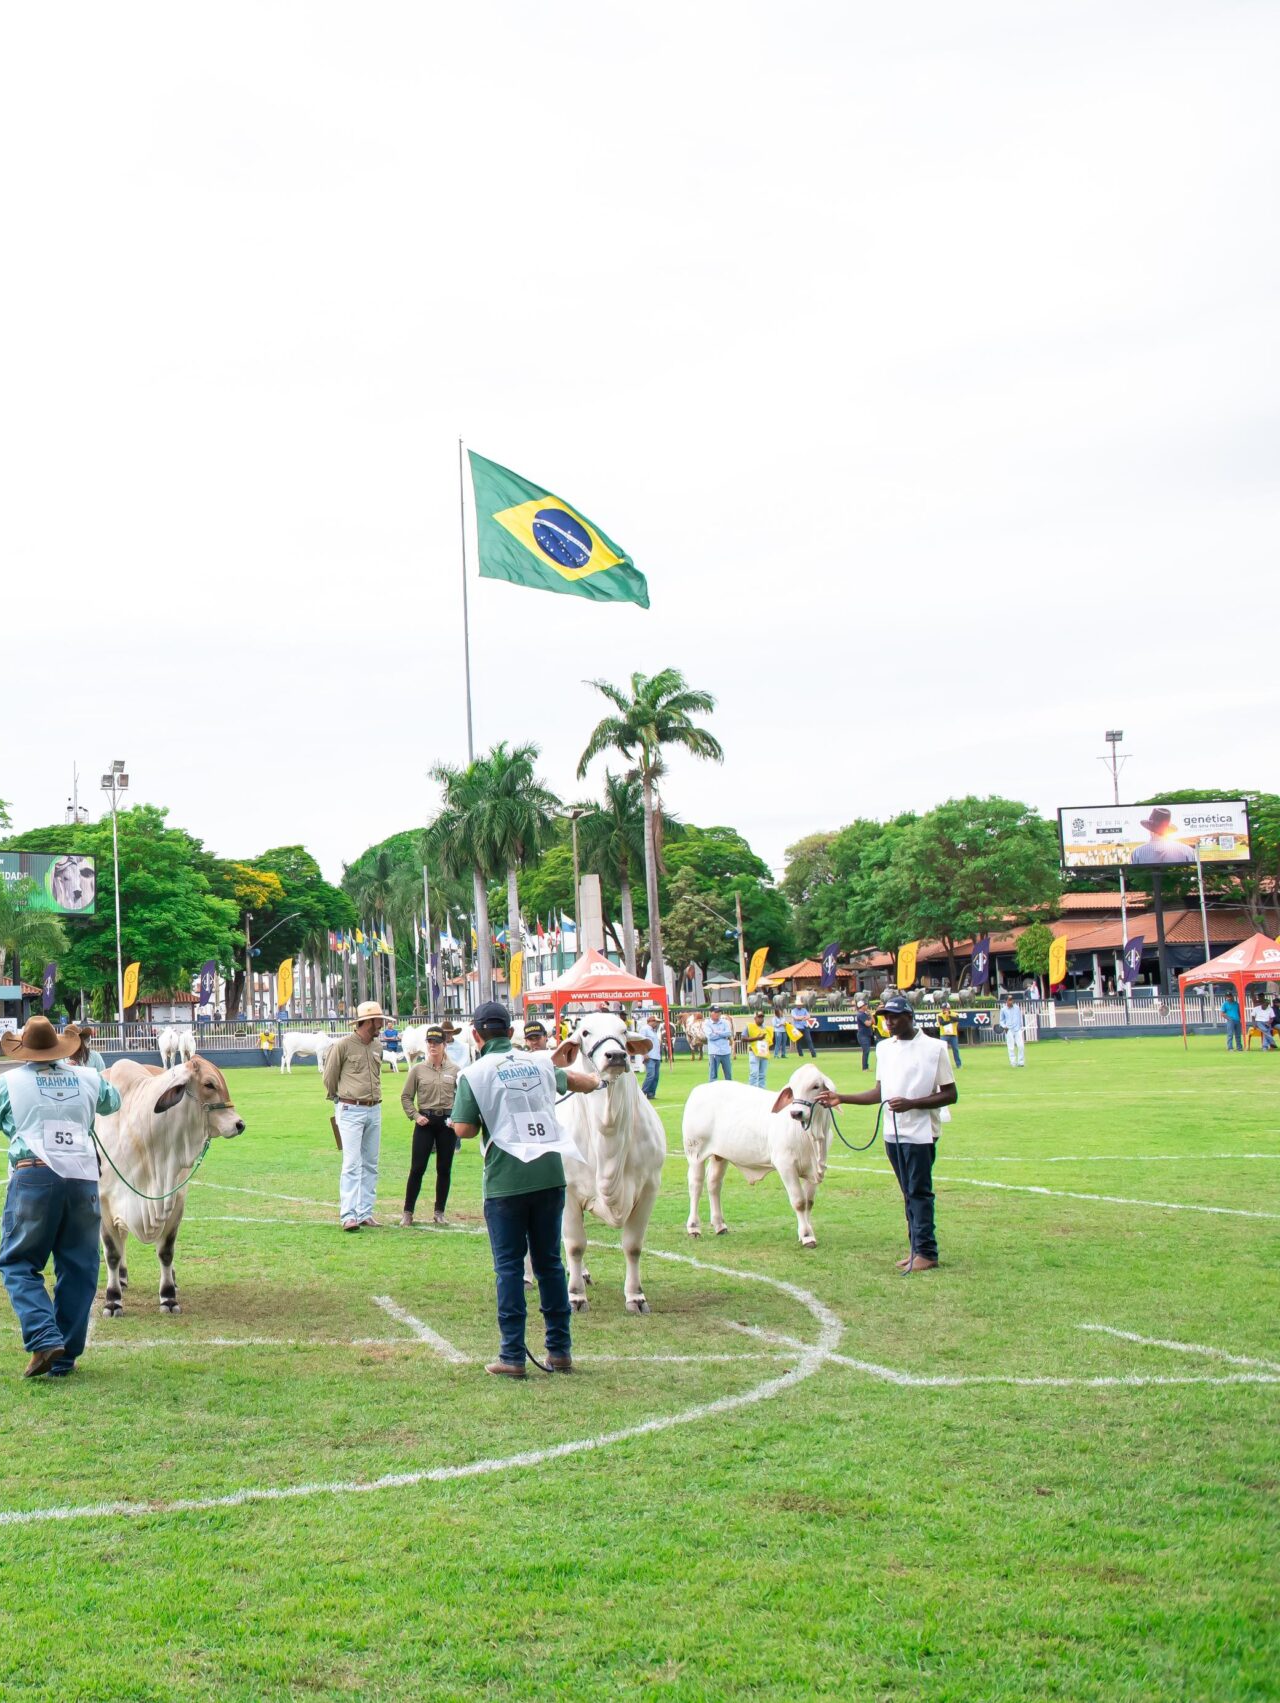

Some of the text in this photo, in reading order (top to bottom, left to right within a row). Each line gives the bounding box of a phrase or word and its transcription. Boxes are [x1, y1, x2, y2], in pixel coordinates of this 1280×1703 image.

[1184, 814, 1233, 826] genética
[571, 990, 650, 1000] www.matsuda.com.br
[497, 1065, 541, 1081] BRAHMAN
[36, 1076, 80, 1087] BRAHMAN
[527, 1122, 546, 1137] 58
[55, 1131, 74, 1145] 53
